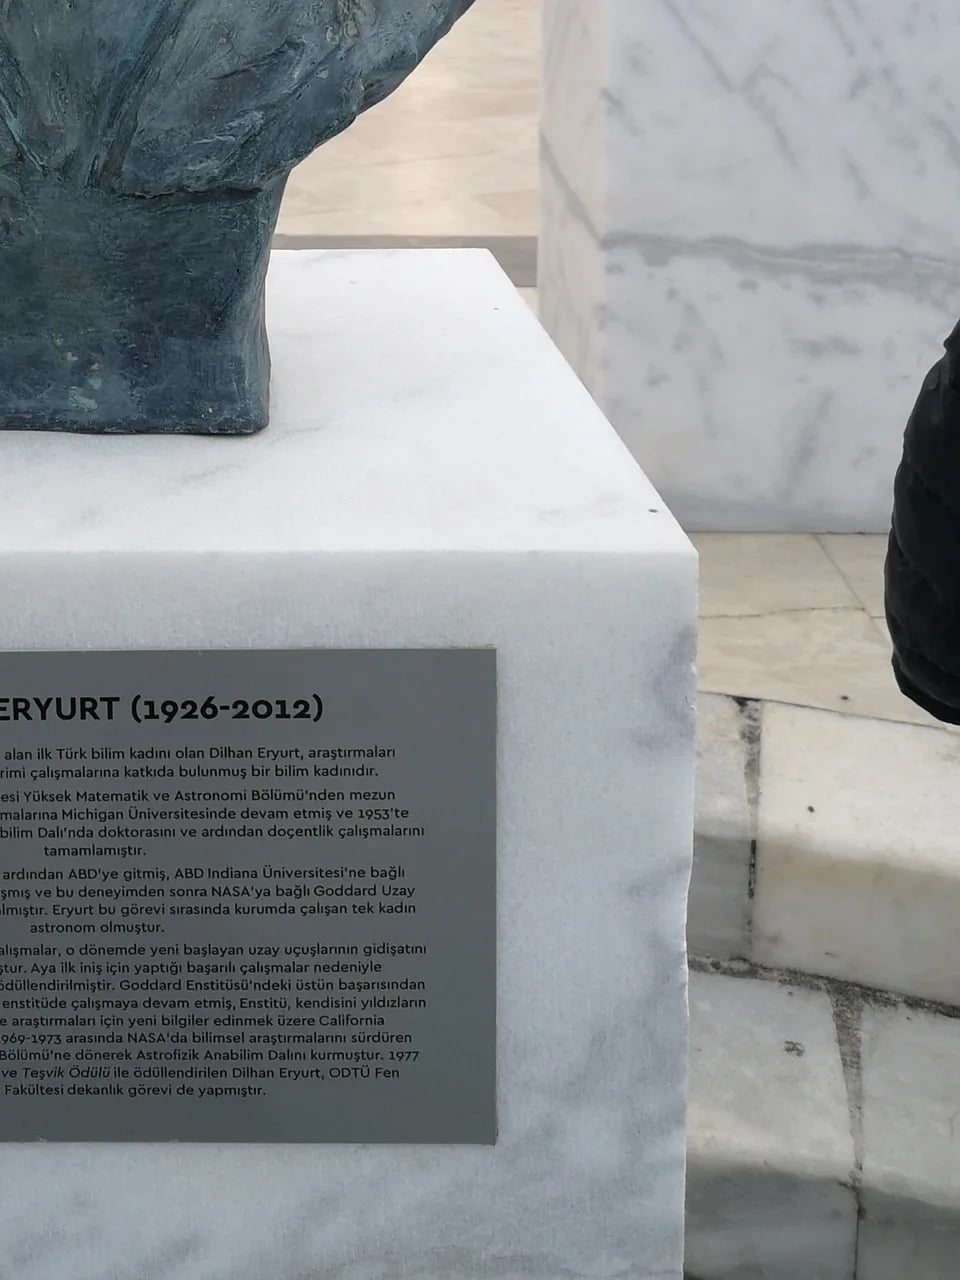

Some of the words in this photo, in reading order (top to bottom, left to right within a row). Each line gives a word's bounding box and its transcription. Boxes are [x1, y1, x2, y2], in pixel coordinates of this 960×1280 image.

[131, 692, 323, 723] (1926-2012)
[4, 748, 32, 760] alan
[37, 747, 53, 760] ilk
[55, 747, 88, 760] Türk
[91, 747, 125, 759] bilim
[129, 747, 171, 759] kadını
[175, 746, 205, 759] olan
[209, 746, 253, 758] Dilhan
[257, 746, 304, 761] Eryurt,
[308, 745, 395, 761] araştırmaları
[30, 765, 120, 781] çalışmalarına
[123, 765, 174, 777] katkıda
[178, 764, 247, 780] bulunmuş
[250, 764, 271, 776] bir
[274, 764, 310, 776] bilim
[313, 763, 378, 776] kadınıdır.
[22, 790, 72, 802] Yüksek
[76, 789, 150, 802] Matematik
[152, 792, 170, 801] ve
[174, 789, 247, 801] Astronomi
[251, 788, 345, 800] Bölümü'nden
[349, 791, 395, 800] mezun
[61, 807, 124, 823] Michigan
[128, 805, 237, 819] Üniversitesinde
[240, 806, 289, 819] devam
[292, 806, 332, 822] etmiş
[335, 809, 354, 818] ve
[357, 805, 409, 820] 1953'te
[43, 843, 146, 859] tamamlamıştır.
[2, 867, 64, 879] ardından
[67, 867, 119, 882] ABD'ye
[120, 866, 170, 882] gitmiş,
[173, 867, 204, 879] ABD
[207, 866, 258, 878] Indiana
[262, 864, 366, 878] Üniversitesi'ne
[370, 865, 405, 878] bağlı
[52, 903, 95, 918] Eryurt
[98, 902, 116, 915] bu
[120, 902, 165, 918] görevi
[169, 902, 230, 914] sırasında
[234, 902, 296, 914] kurumda
[299, 901, 348, 917] çalışan
[351, 901, 374, 914] tek
[378, 901, 416, 914] kadın
[30, 921, 96, 933] astronom
[98, 920, 165, 936] olmuştur.
[78, 943, 146, 955] dönemde
[150, 942, 179, 958] yeni
[183, 942, 244, 958] başlayan
[248, 945, 282, 958] uzay
[284, 942, 358, 958] uçuşlarının
[362, 941, 426, 957] gidişatını
[30, 961, 58, 976] Aya
[58, 960, 76, 973] ilk
[77, 960, 103, 976] iniş
[105, 960, 130, 976] için
[130, 960, 182, 976] yaptığı
[186, 960, 236, 976] başarılı
[239, 960, 310, 976] çalışmalar
[313, 960, 382, 976] nedeniyle
[119, 978, 182, 991] Goddard
[186, 978, 292, 990] Enstitüsü'ndeki
[295, 978, 334, 990] üstün
[338, 977, 425, 993] başarısından
[65, 1031, 124, 1043] arasında
[127, 1031, 191, 1043] NASA'da
[192, 1030, 245, 1043] bilimsel
[247, 1030, 347, 1046] araştırmalarını
[349, 1030, 412, 1043] sürdüren
[74, 1048, 132, 1060] dönerek
[135, 1048, 200, 1060] Astrofizik
[203, 1048, 264, 1060] Anabilim
[265, 1048, 306, 1060] Dalını
[307, 1047, 384, 1063] kurmuştur.
[388, 1051, 420, 1062] 1977
[0, 1069, 18, 1078] ve
[20, 1065, 65, 1081] Teşvik
[66, 1063, 111, 1078] Ödülü
[113, 1065, 130, 1078] ile
[133, 1065, 230, 1078] ödüllendirilen
[232, 1065, 274, 1078] Dilhan
[278, 1066, 324, 1081] Eryurt,
[328, 1063, 370, 1078] ODTÜ
[374, 1066, 400, 1078] Fen
[4, 1083, 64, 1095] Fakültesi
[66, 1083, 124, 1095] dekanlık
[127, 1082, 172, 1098] görevi
[176, 1082, 194, 1095] de
[198, 1083, 266, 1098] yapmıştır.
